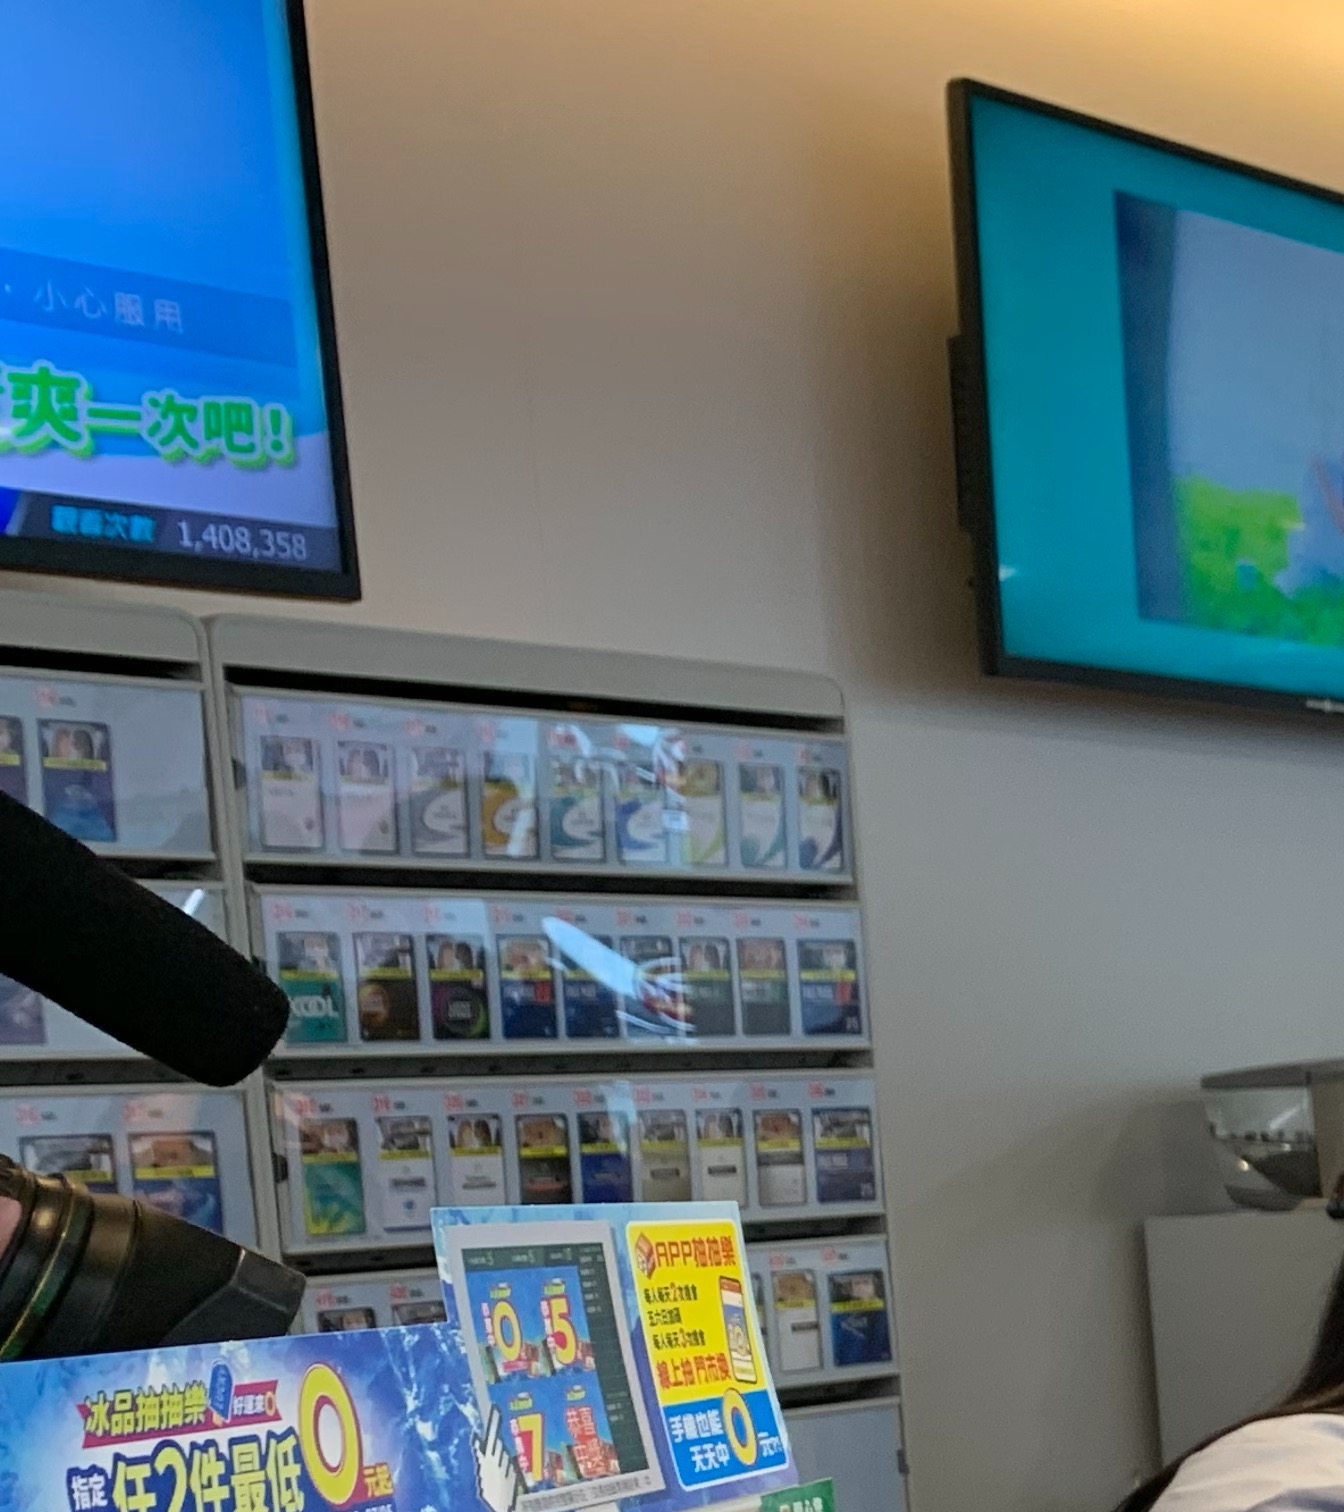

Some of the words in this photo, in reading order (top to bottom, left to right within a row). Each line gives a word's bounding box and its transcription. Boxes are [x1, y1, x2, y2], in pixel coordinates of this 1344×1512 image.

[0, 366, 288, 456] 爽一次吧!
[177, 520, 307, 561] 1,408,358
[83, 1381, 208, 1436] 冰品抽抽樂
[71, 1473, 108, 1511] 指定
